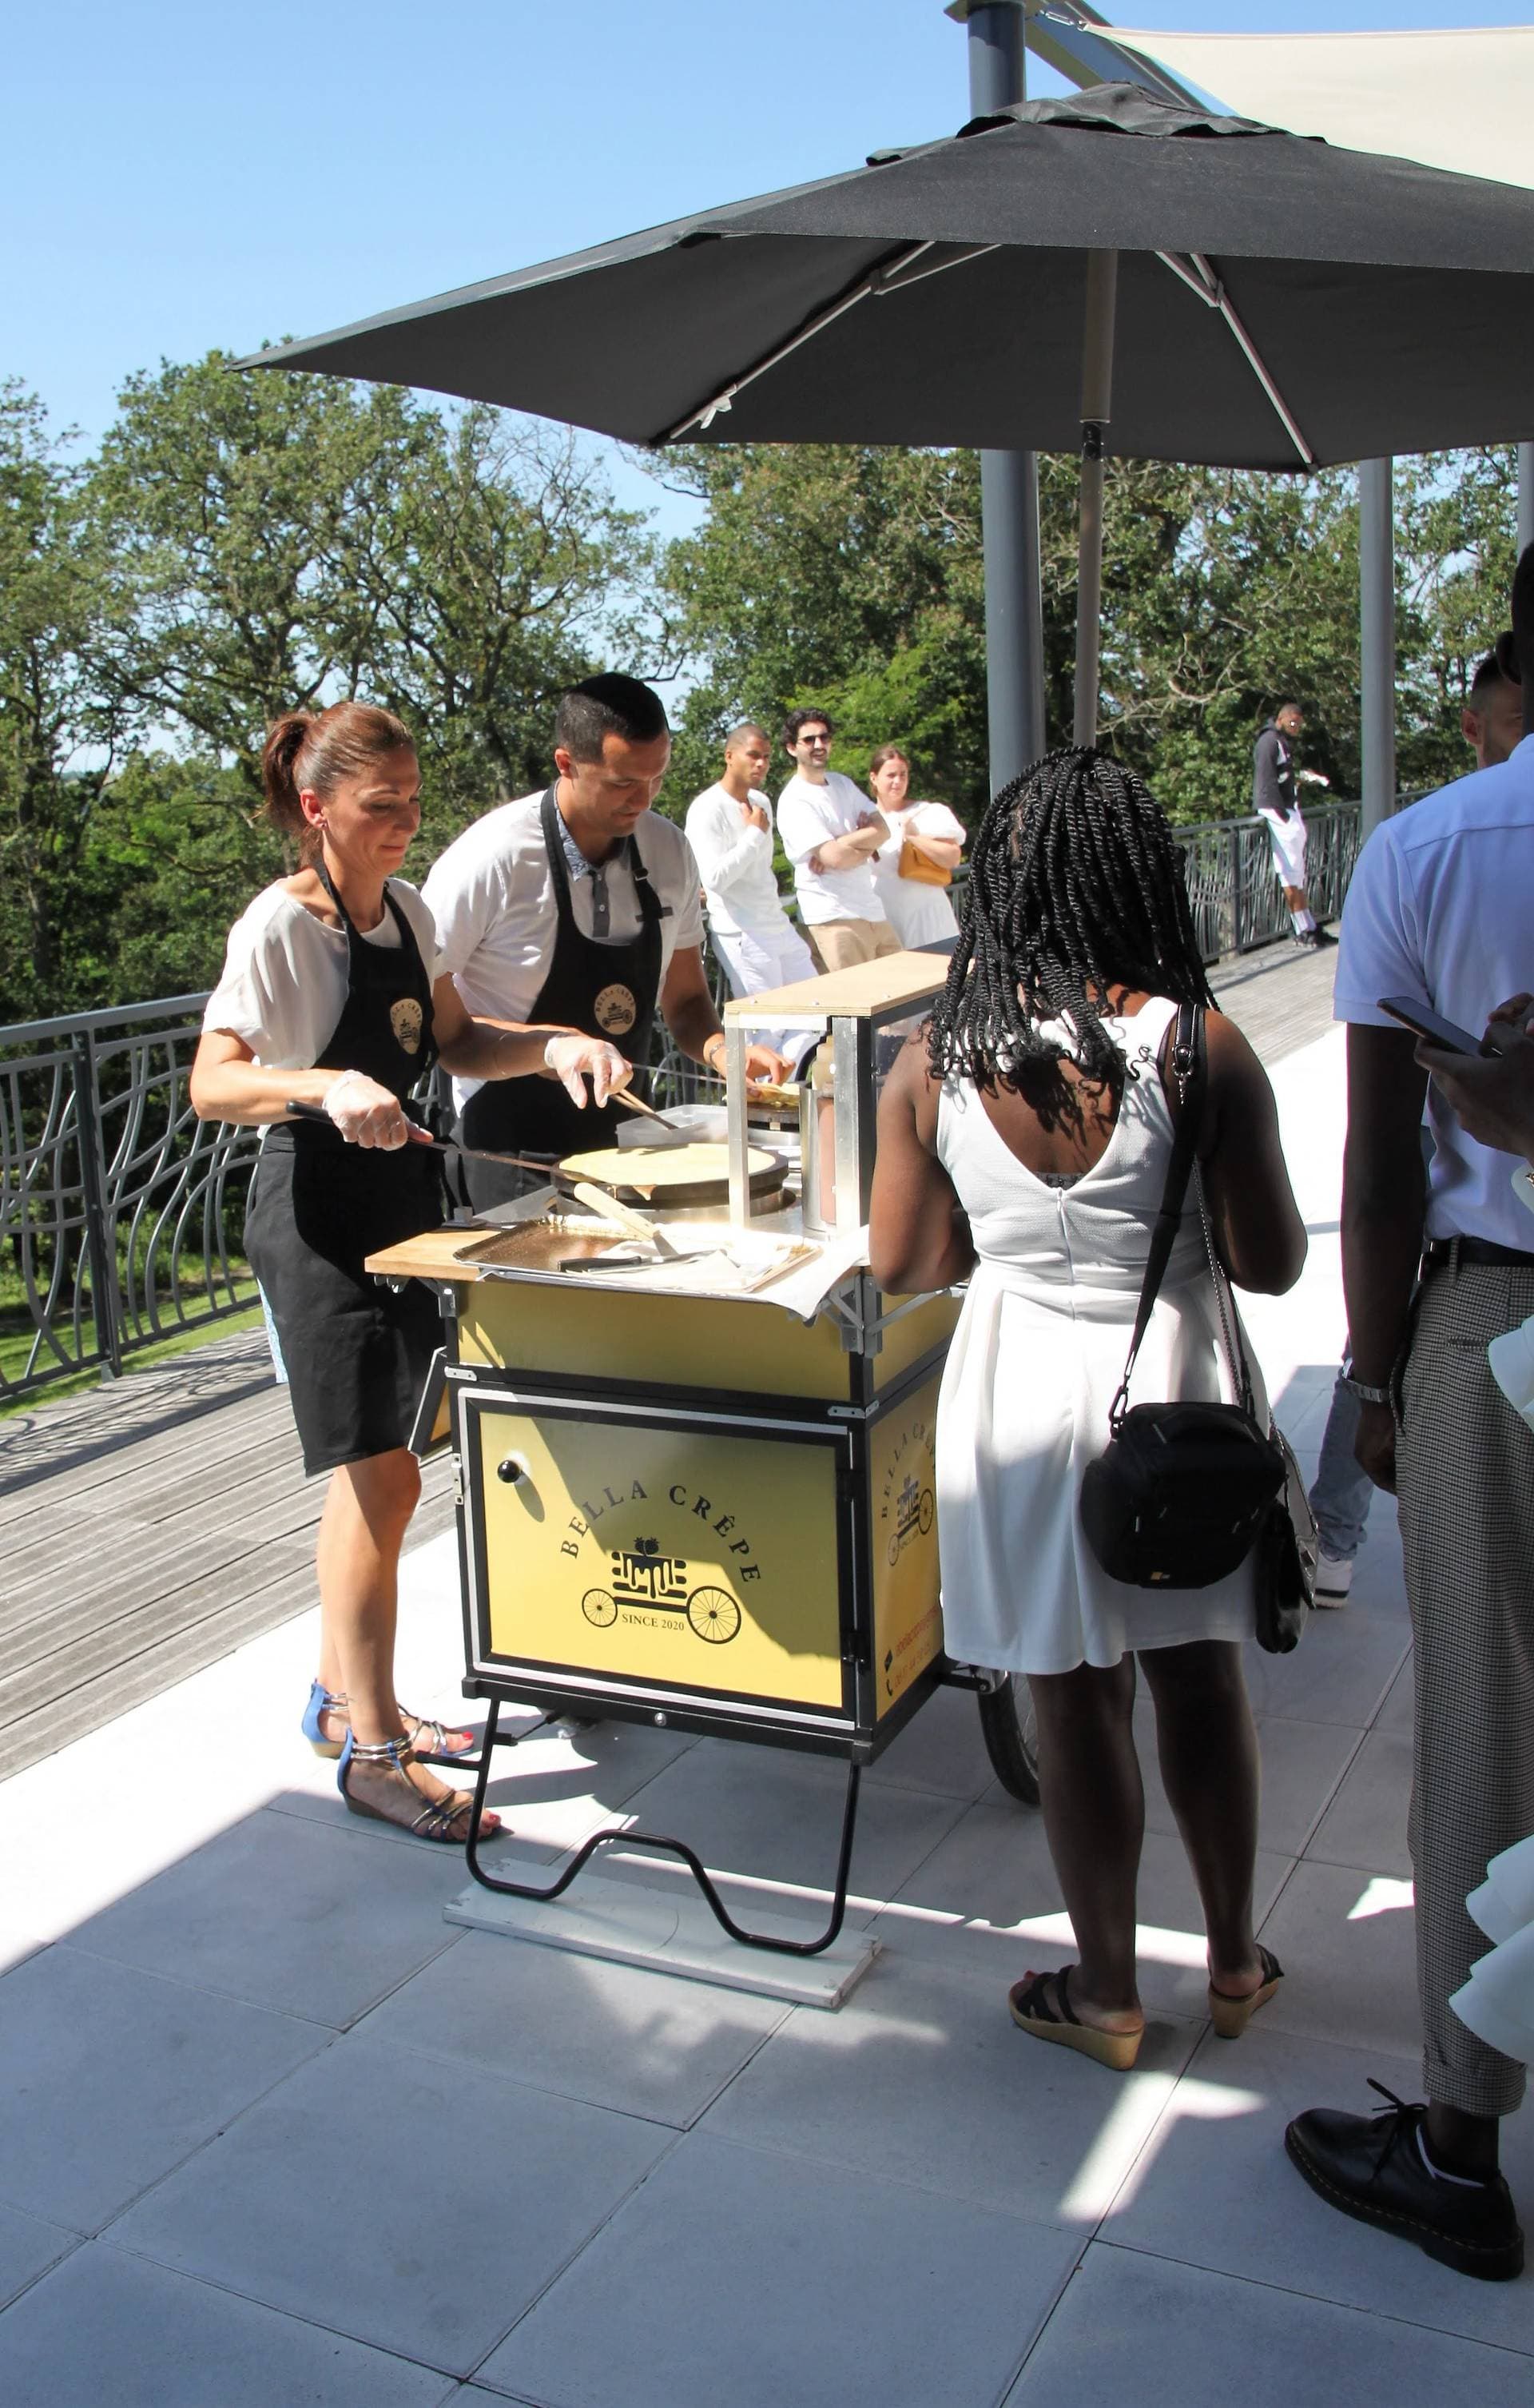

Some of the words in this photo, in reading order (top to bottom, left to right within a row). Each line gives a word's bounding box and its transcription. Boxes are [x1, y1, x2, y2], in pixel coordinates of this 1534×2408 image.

[561, 1479, 648, 1558] BELLA
[669, 1485, 761, 1582] CRÊPE
[622, 1613, 658, 1627] SINCE
[662, 1619, 685, 1631] 2020
